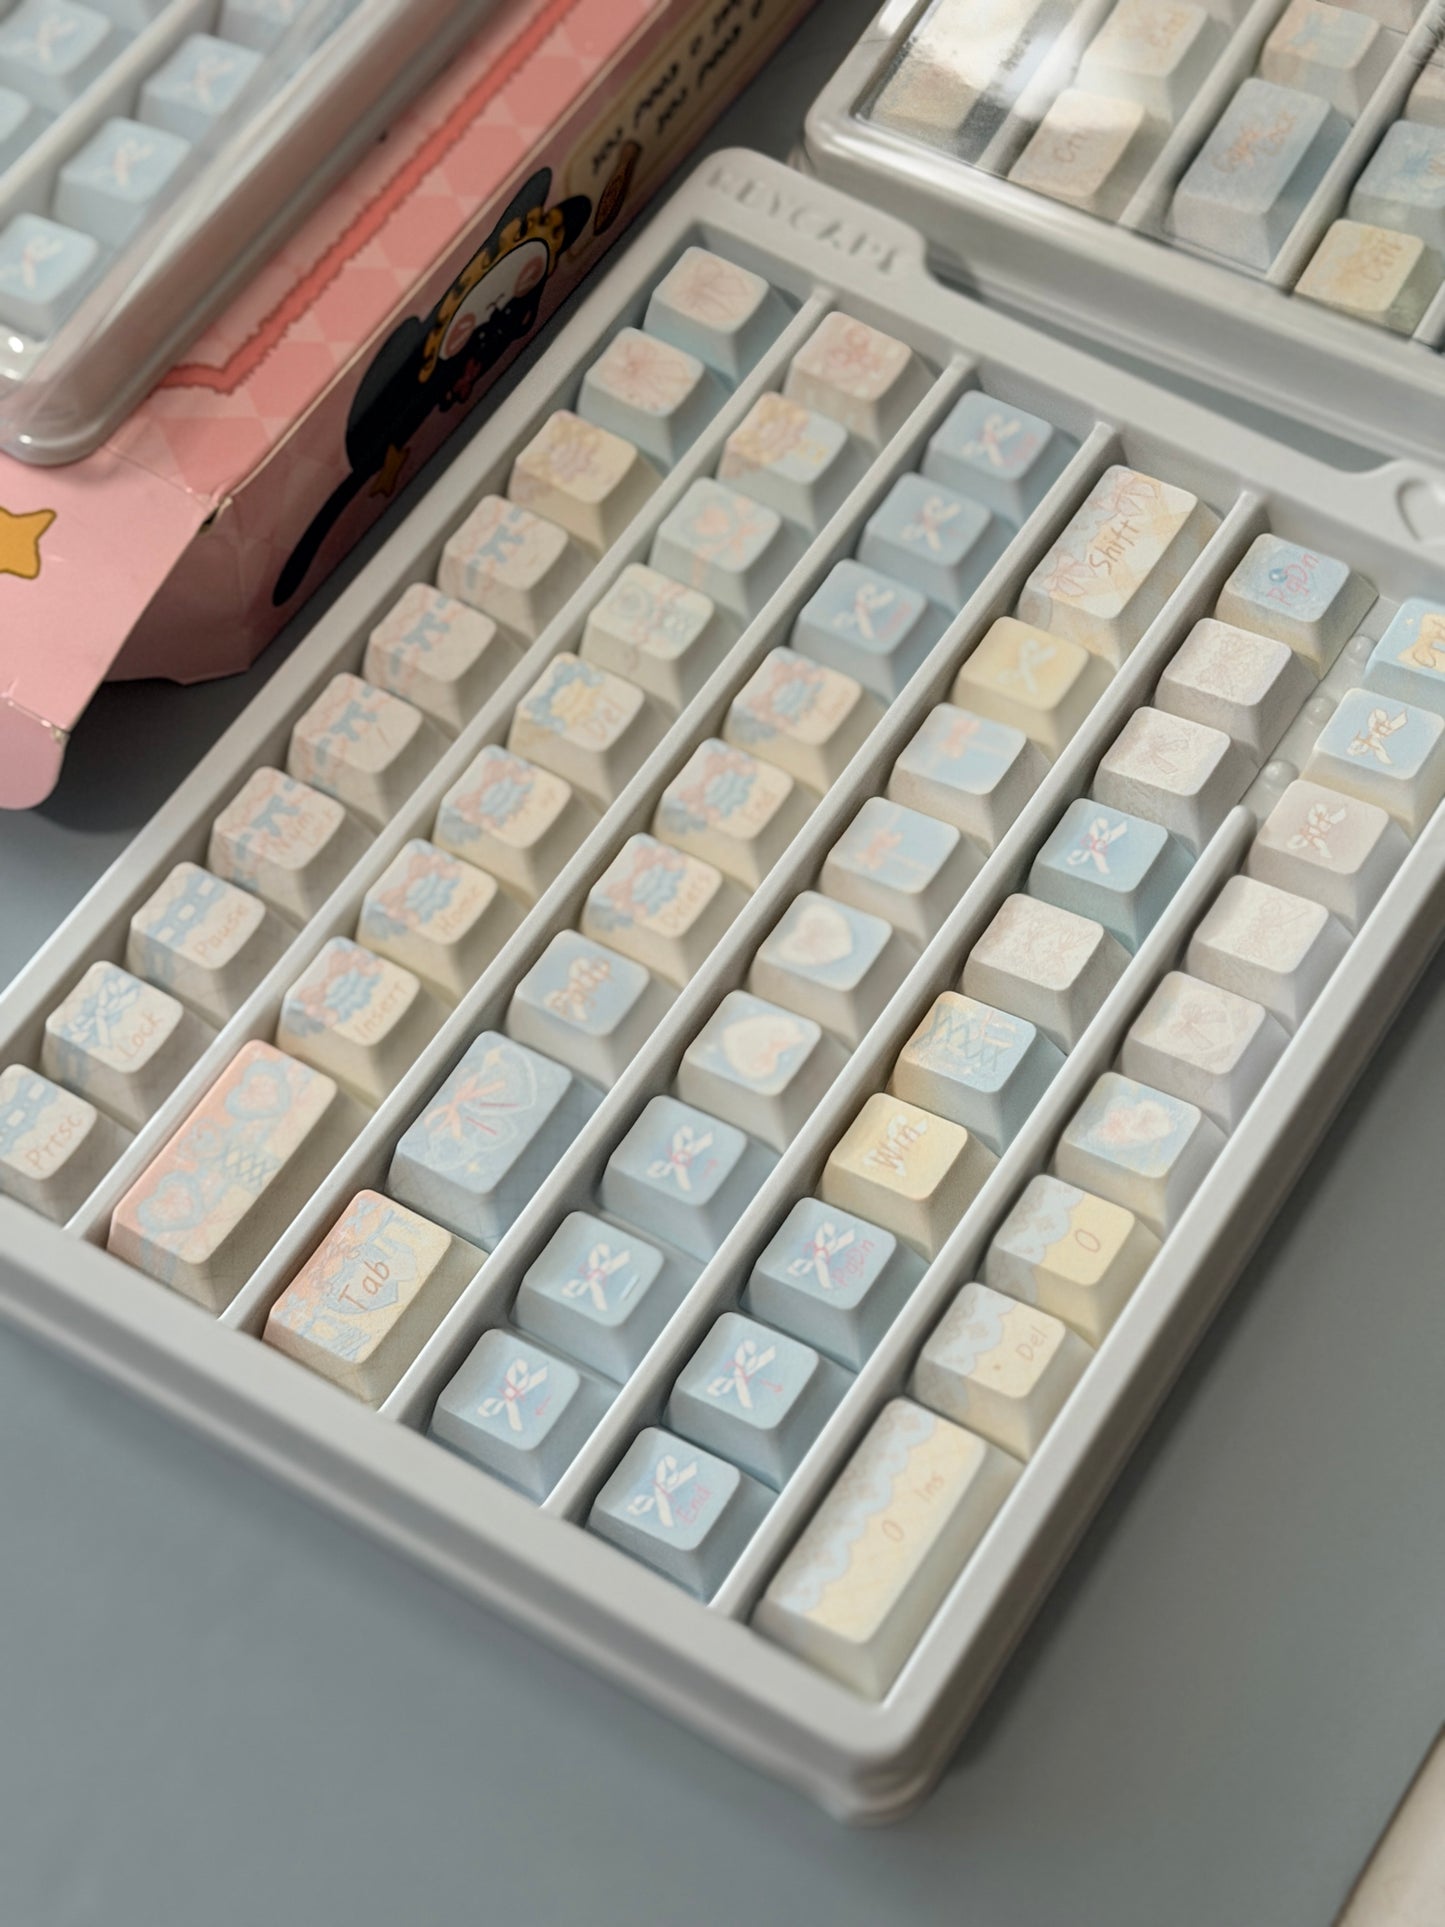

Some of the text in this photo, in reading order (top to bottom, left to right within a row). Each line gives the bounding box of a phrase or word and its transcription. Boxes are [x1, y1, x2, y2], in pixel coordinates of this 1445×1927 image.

[1088, 519, 1141, 575] Shift
[1268, 553, 1320, 606] PgDn
[354, 981, 411, 1039] Insert
[114, 1012, 165, 1060] Lock
[872, 1125, 922, 1169] Win
[338, 1259, 391, 1310] Tab
[1014, 1328, 1047, 1362] Del
[675, 1482, 713, 1526] End
[913, 1471, 947, 1503] Ins
